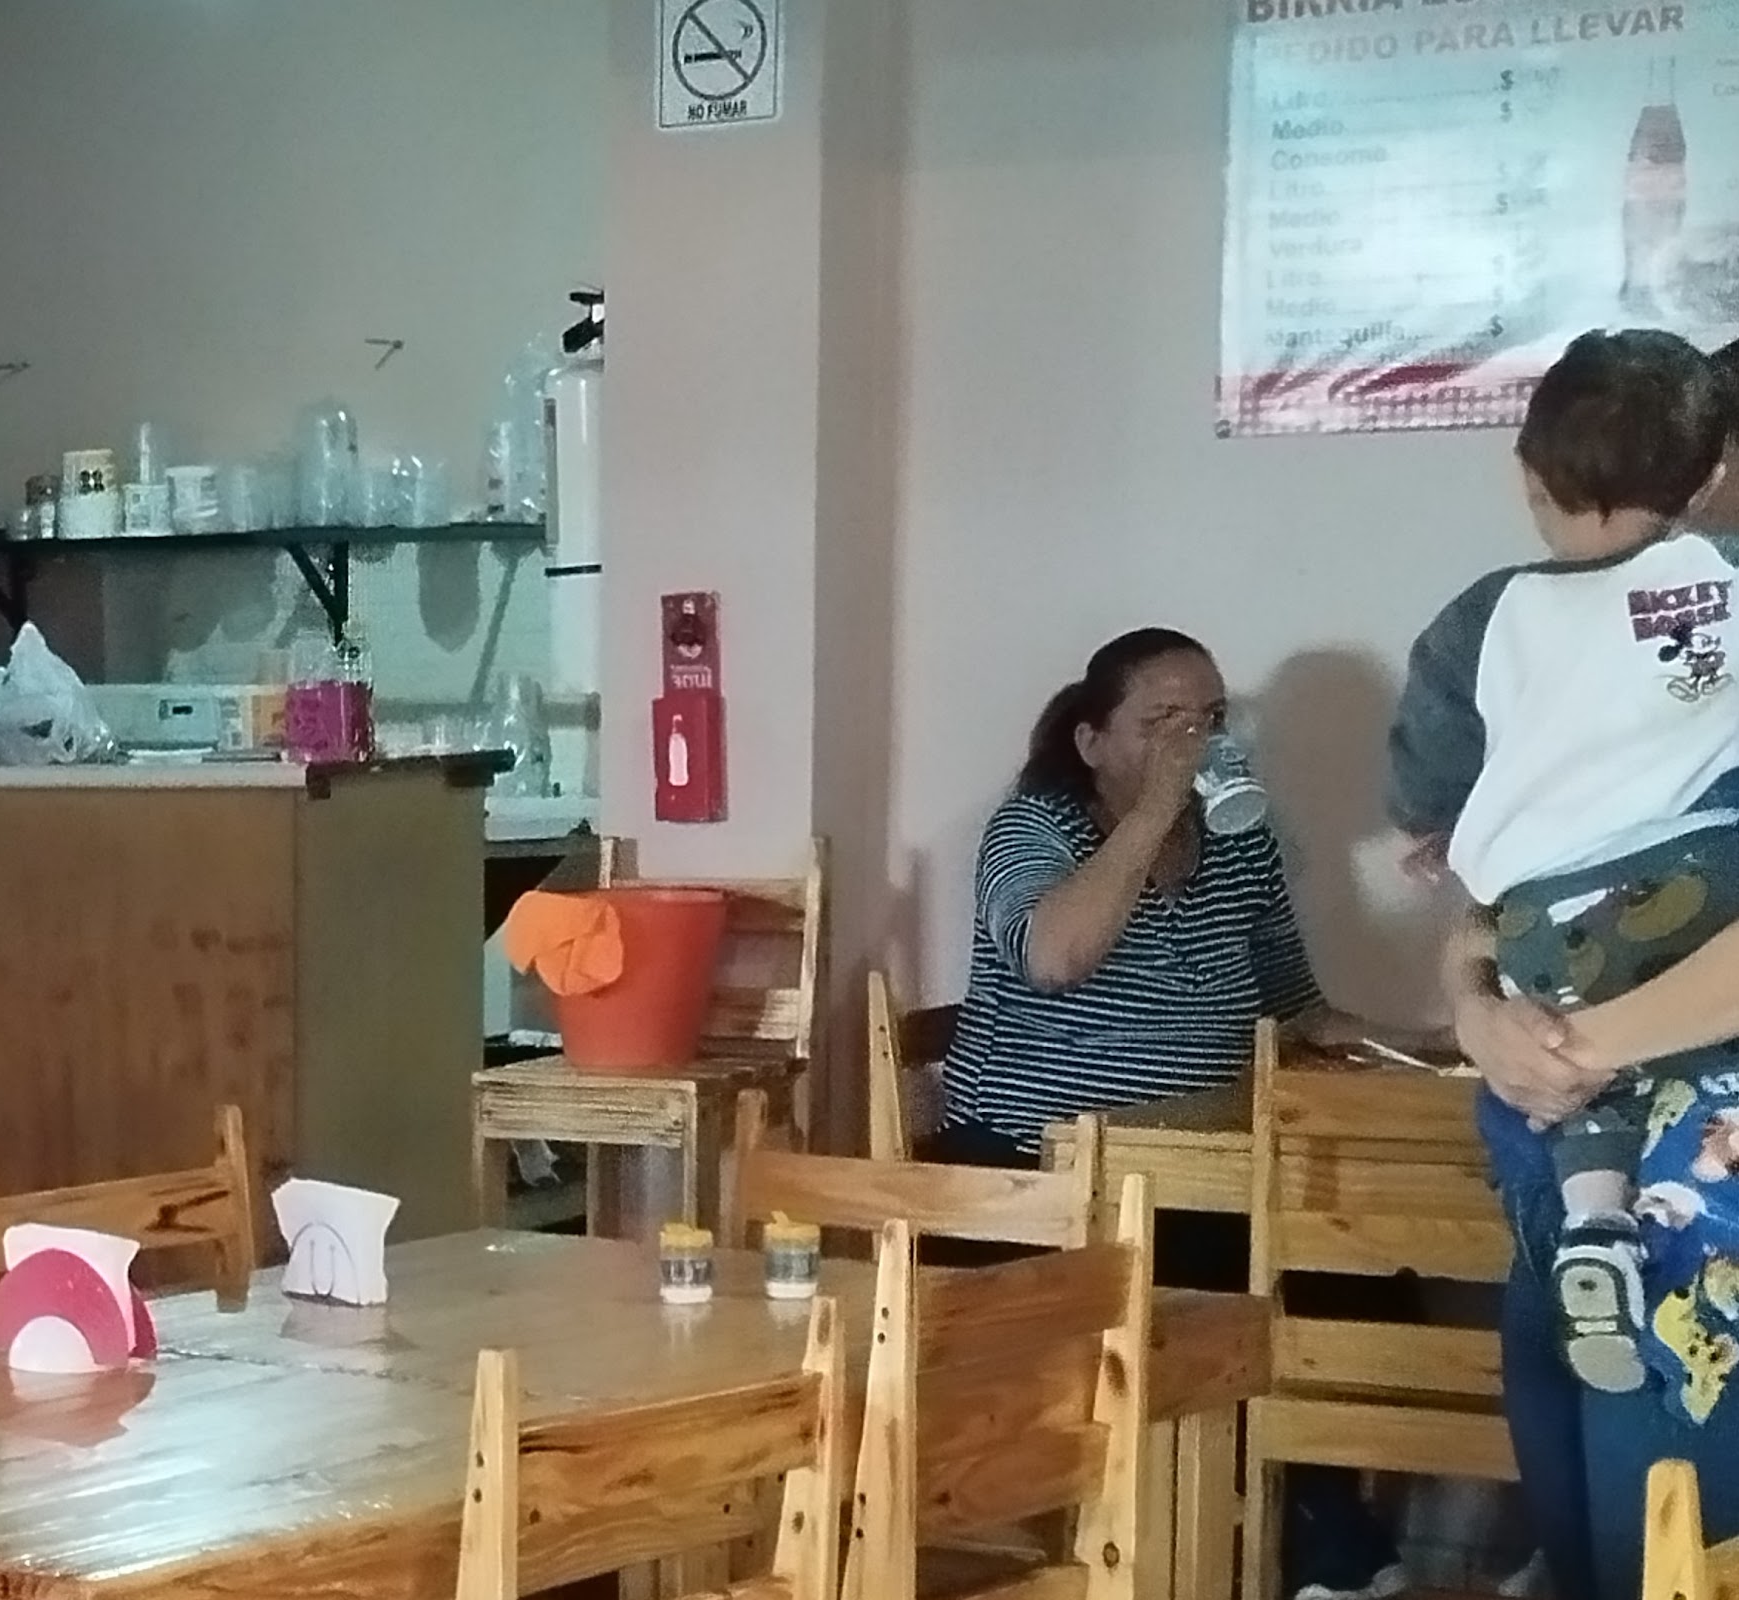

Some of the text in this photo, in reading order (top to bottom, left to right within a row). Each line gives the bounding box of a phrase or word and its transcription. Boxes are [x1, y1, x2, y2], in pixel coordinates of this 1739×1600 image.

[1415, 20, 1515, 55] PARA
[1531, 3, 1684, 46] LLEVAR
[687, 99, 748, 121] NO FUMAR
[1272, 118, 1344, 140] Medio
